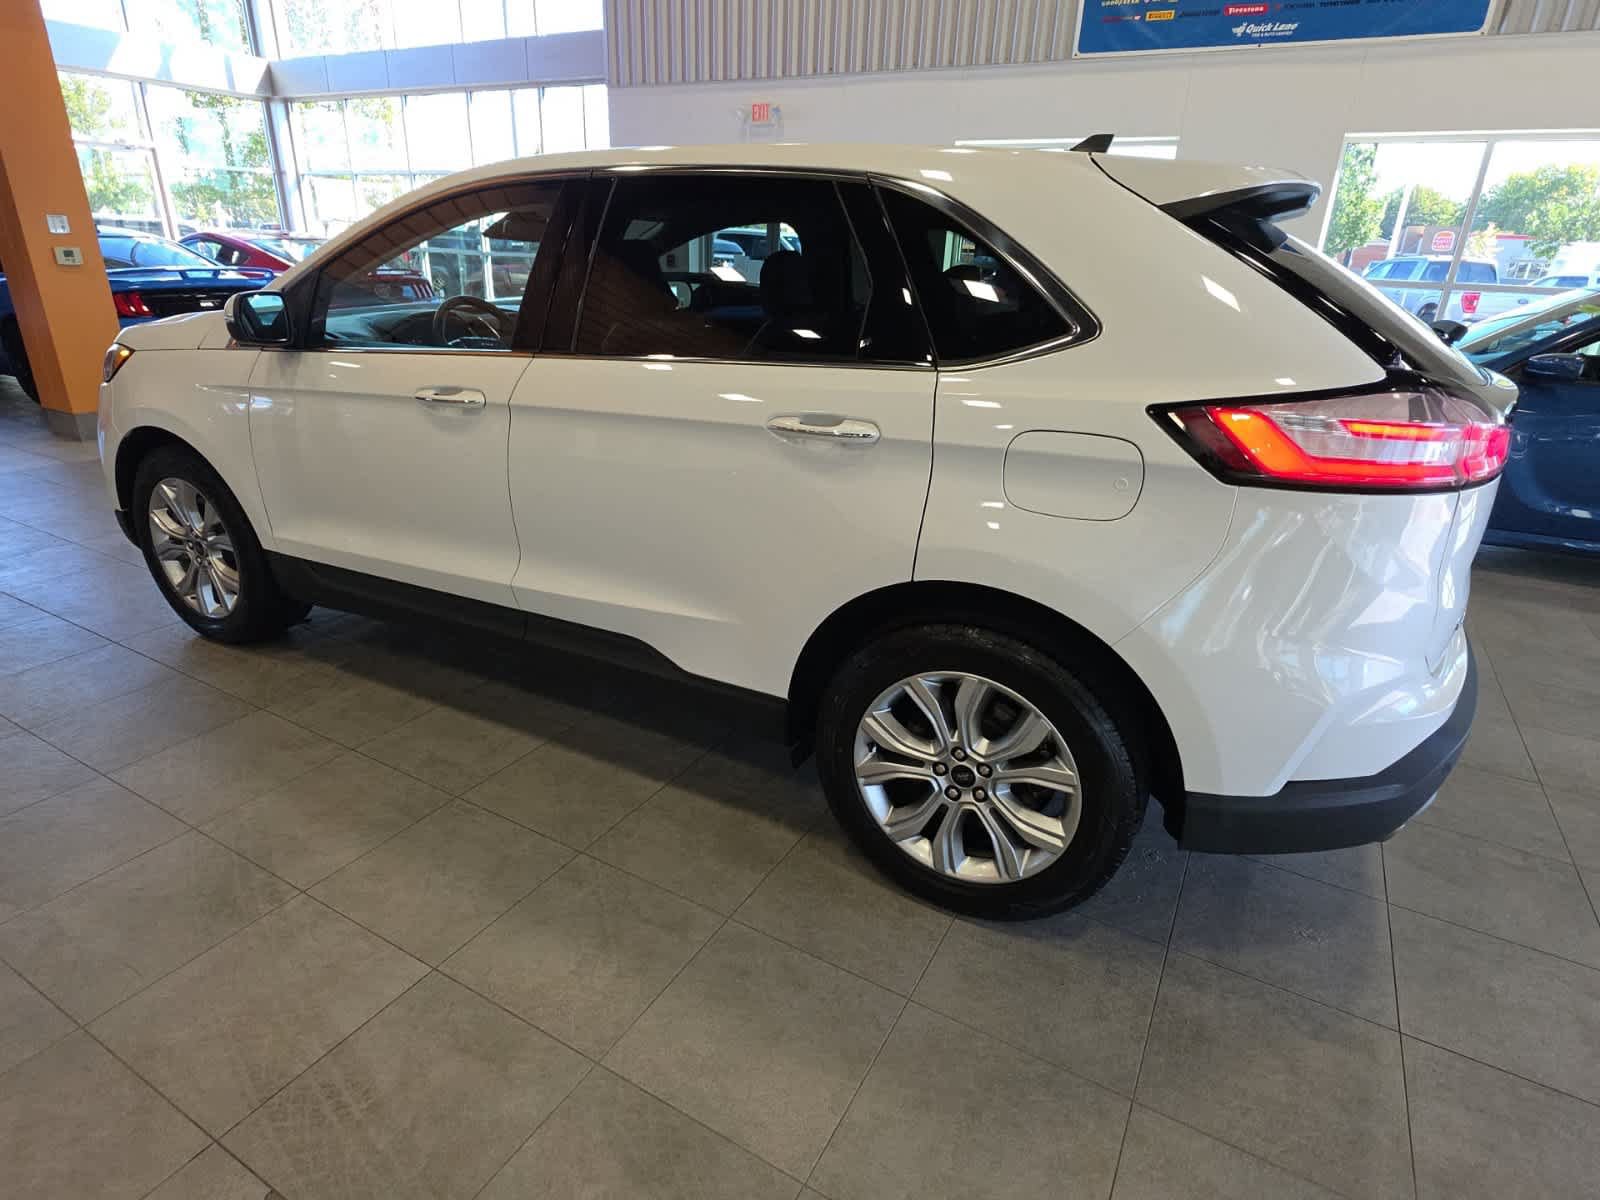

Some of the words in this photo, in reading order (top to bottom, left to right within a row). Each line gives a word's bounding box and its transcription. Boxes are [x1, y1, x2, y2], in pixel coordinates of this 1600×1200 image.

[1228, 6, 1265, 15] Firestone
[1246, 22, 1273, 34] Quick
[1272, 22, 1299, 31] Lane
[751, 103, 769, 121] EXIT
